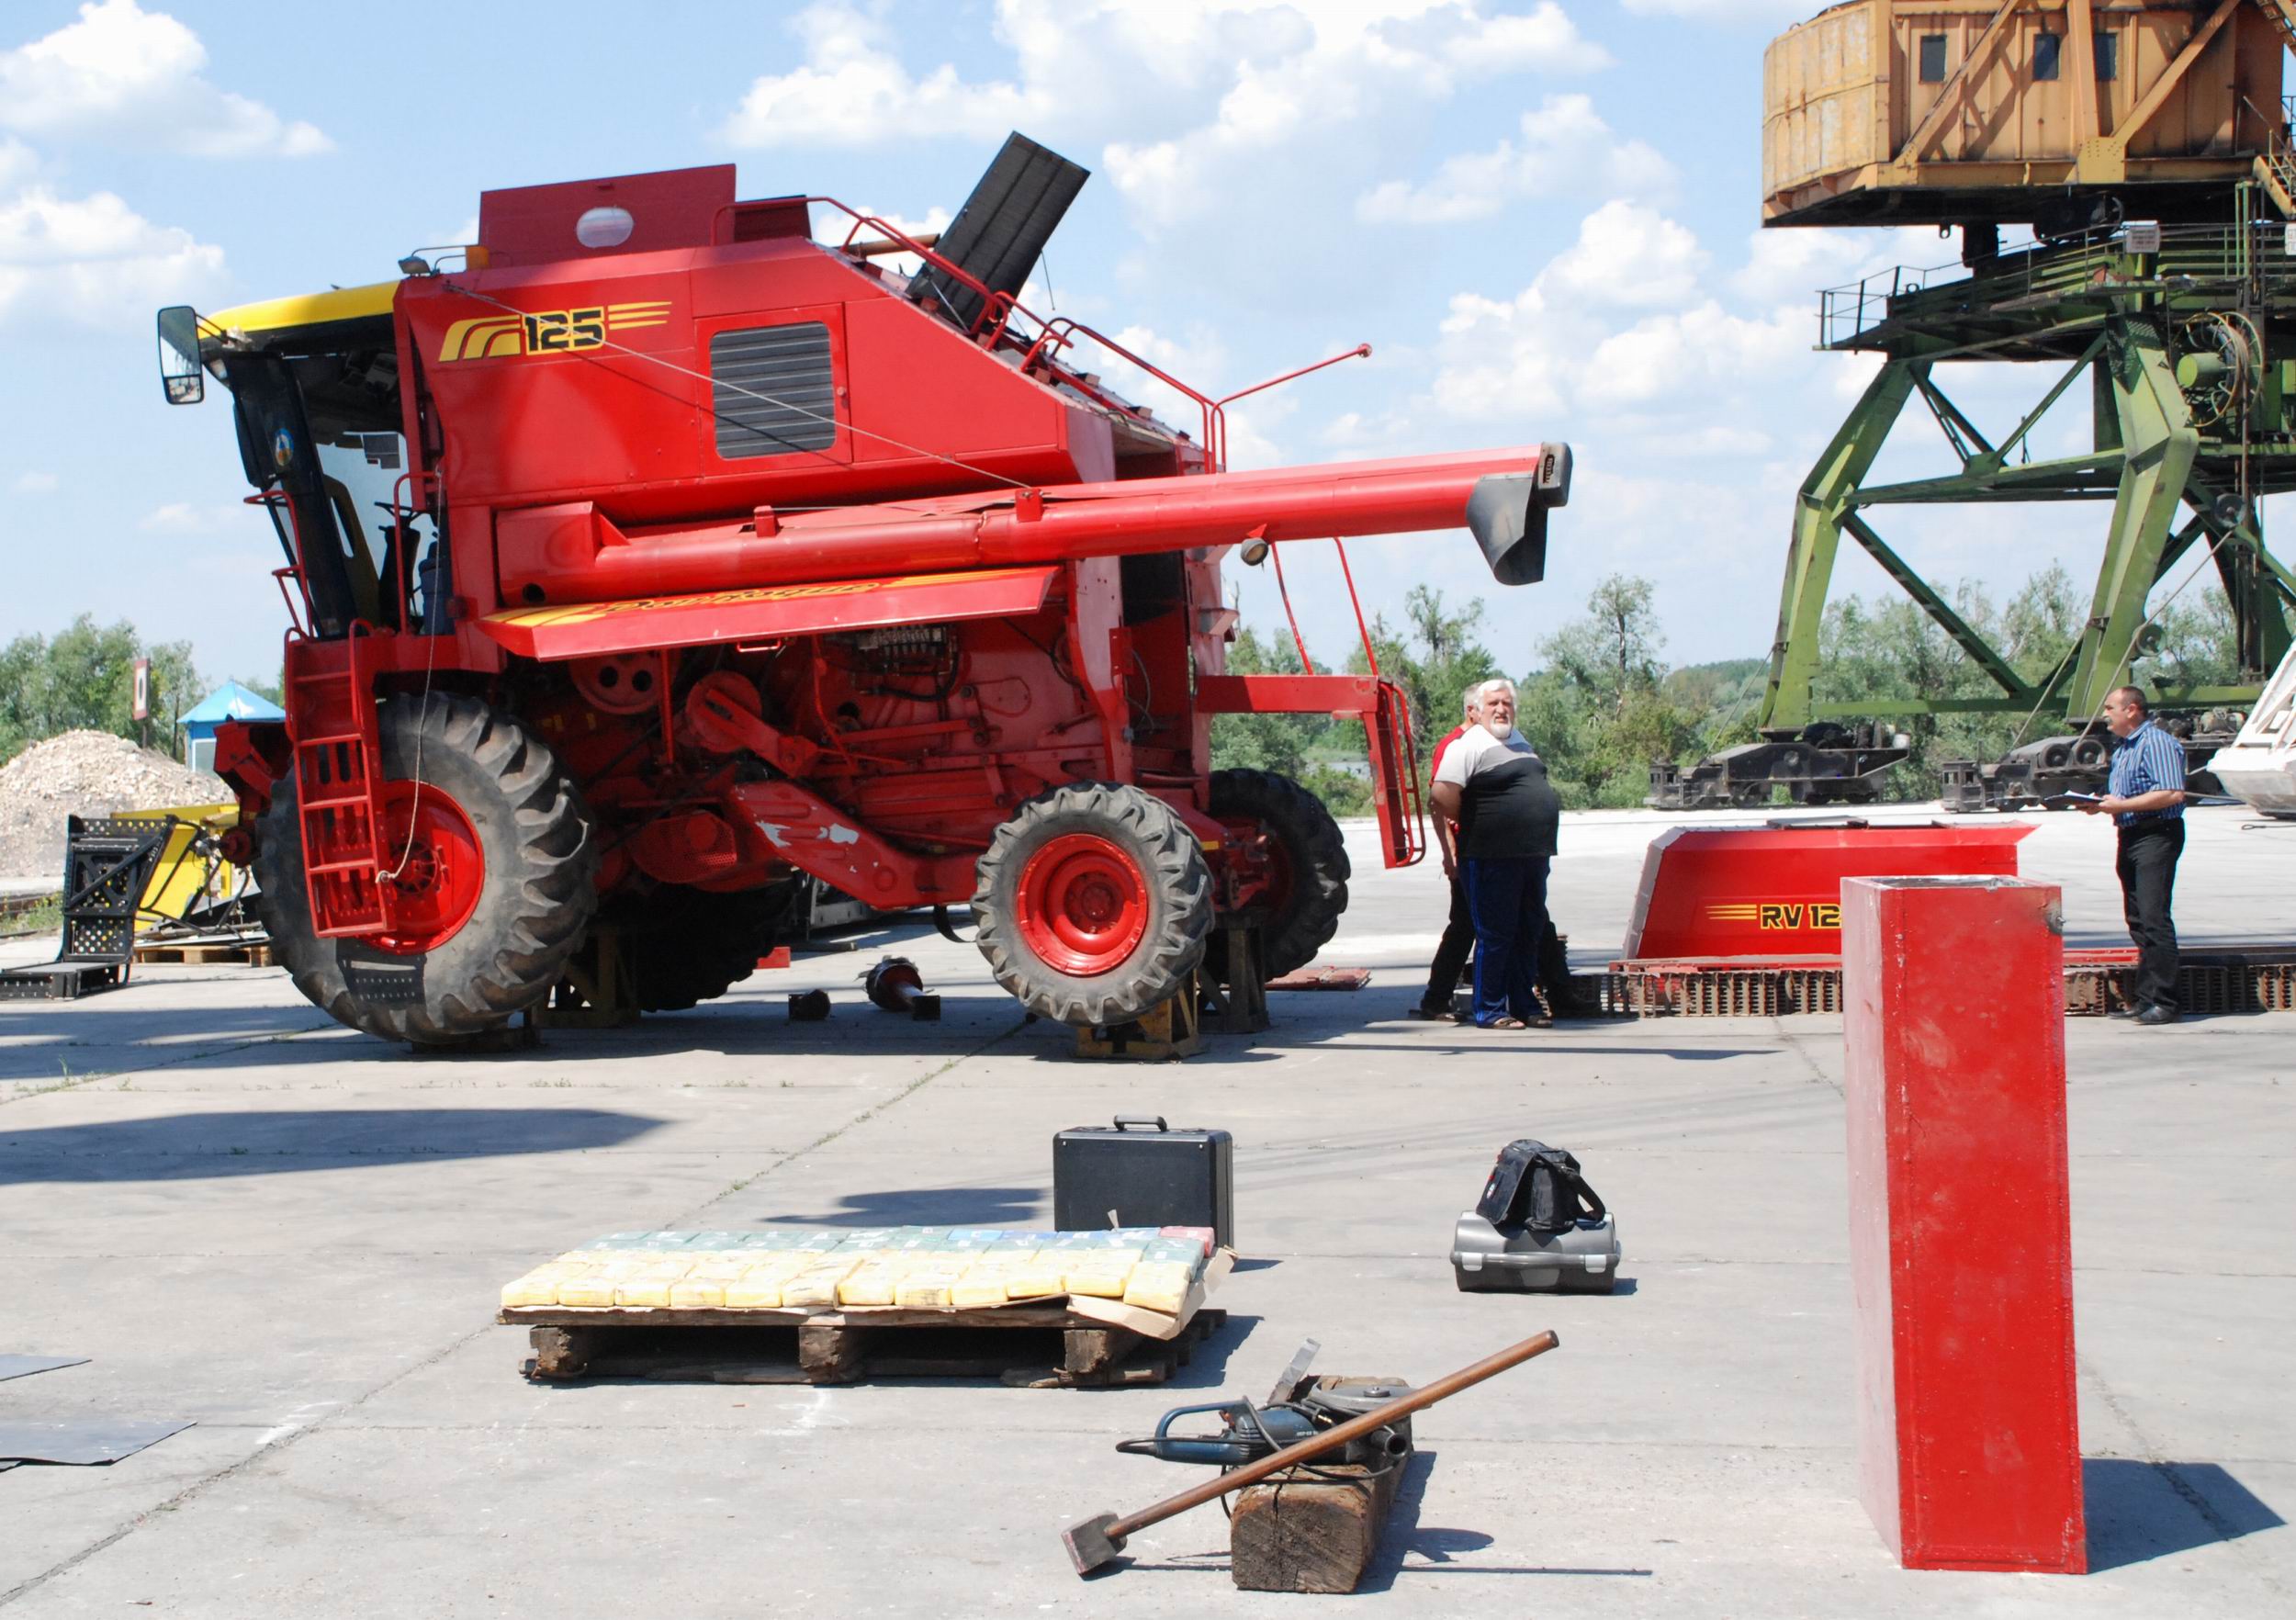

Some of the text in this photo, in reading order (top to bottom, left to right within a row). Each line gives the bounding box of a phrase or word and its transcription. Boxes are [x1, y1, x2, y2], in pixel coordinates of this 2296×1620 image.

[522, 306, 606, 356] 125
[1760, 903, 1842, 930] RV 12
